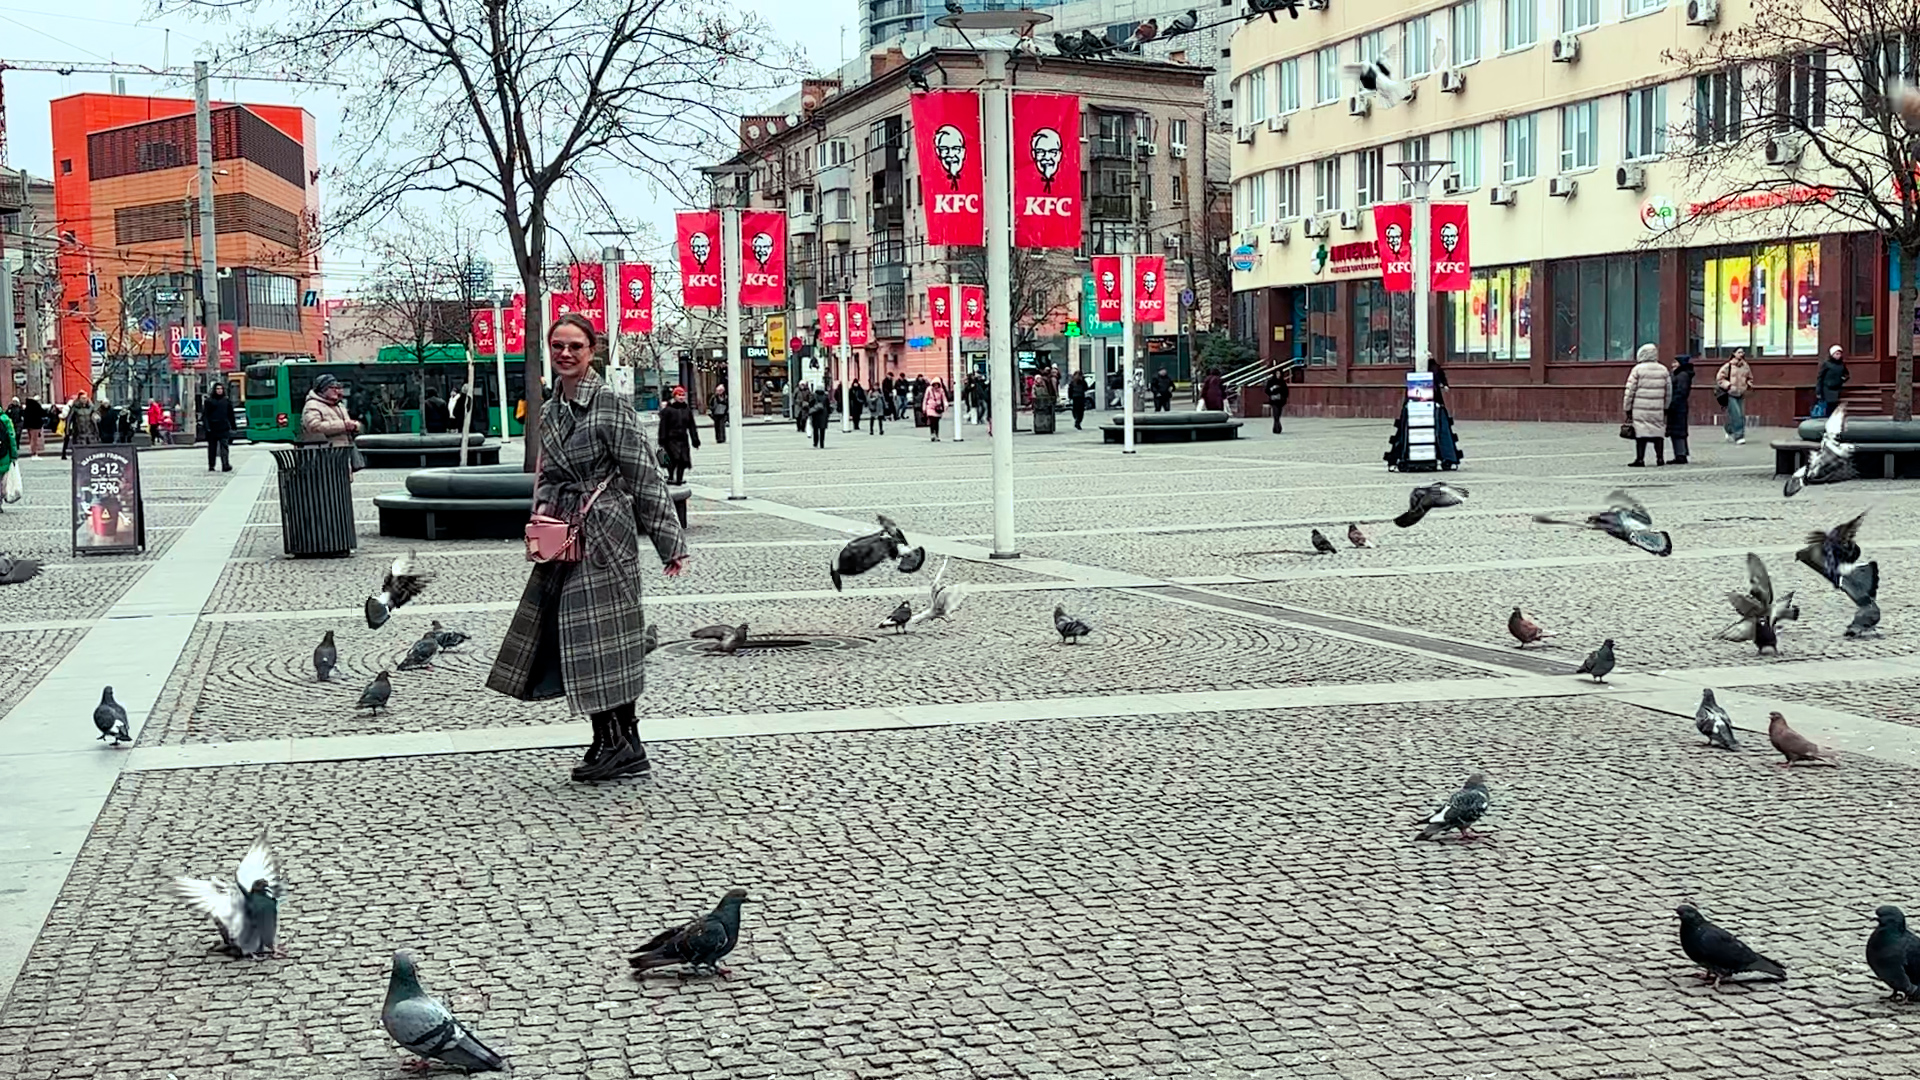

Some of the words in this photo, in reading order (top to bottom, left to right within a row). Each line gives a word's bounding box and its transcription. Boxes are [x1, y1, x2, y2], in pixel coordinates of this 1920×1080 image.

[933, 194, 978, 213] KFC
[1023, 197, 1072, 216] KFC
[1387, 262, 1412, 274] KFC
[1434, 262, 1465, 274] KFC
[688, 274, 717, 287] KFC
[745, 273, 778, 287] KFC
[1101, 300, 1119, 309] KFC
[1139, 300, 1161, 309] KFC
[624, 309, 649, 319] KFC
[934, 320, 949, 328] KFC
[963, 320, 981, 328] KFC
[850, 330, 866, 338] KFC
[95, 340, 103, 350] P
[479, 338, 493, 346] KFC
